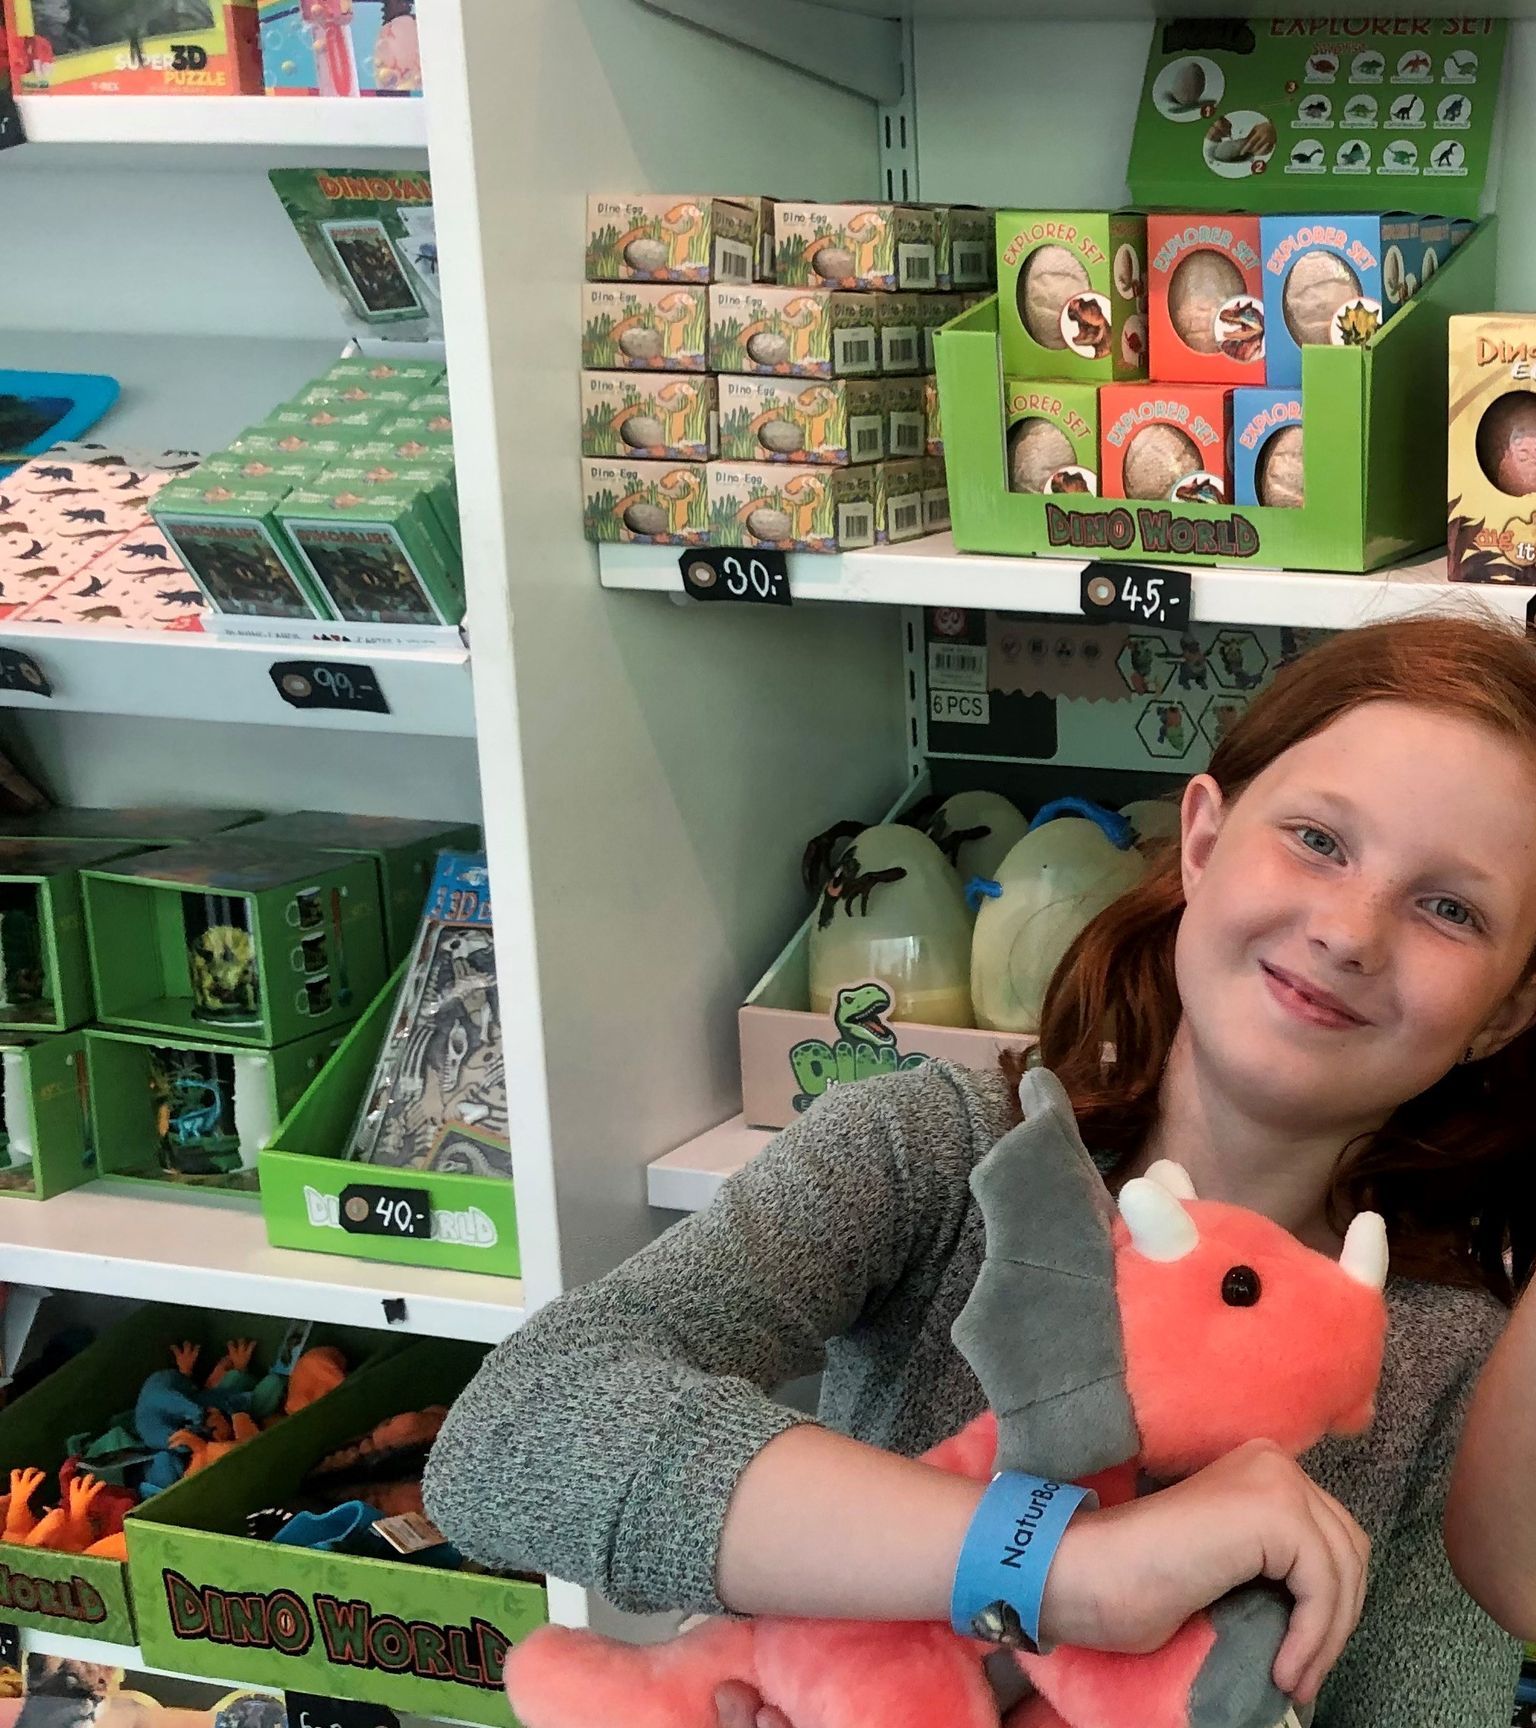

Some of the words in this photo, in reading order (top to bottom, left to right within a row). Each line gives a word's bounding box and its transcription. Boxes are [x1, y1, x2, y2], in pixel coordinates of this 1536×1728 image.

[171, 45, 208, 71] 3D
[164, 71, 227, 86] PUZZLE
[317, 175, 433, 201] DINOSA
[597, 203, 622, 215] Dino
[626, 204, 644, 216] Egg
[783, 212, 806, 223] Dino
[810, 213, 827, 225] Egg
[1003, 223, 1078, 267] EXPLORER
[1077, 235, 1106, 266] SET
[1153, 226, 1232, 274] EXPLORER
[1231, 239, 1261, 272] SET
[1266, 226, 1349, 277] EXPLORER
[1346, 239, 1378, 272] SET
[591, 292, 615, 303] Dino
[619, 293, 637, 305] Egg
[719, 294, 741, 306] Dino
[745, 295, 763, 308] Egg
[590, 380, 615, 392] Dino
[618, 381, 637, 394] Egg
[728, 383, 752, 395] Dino
[756, 385, 775, 397] Egg
[1005, 393, 1062, 416] LORER
[1063, 409, 1092, 441] SET
[1107, 401, 1188, 447] EXPLORER
[1190, 416, 1219, 448] SET
[1239, 401, 1302, 449] EXPLOR
[590, 468, 615, 479] Dino
[619, 470, 638, 481] Egg
[715, 472, 739, 484] Dino
[743, 474, 763, 486] Egg
[1045, 502, 1136, 552] DINO
[1137, 508, 1260, 558] WORLD
[1473, 527, 1515, 552] dig
[1515, 543, 1536, 561] it
[933, 696, 943, 714] 6
[947, 696, 983, 717] PCS
[430, 1206, 498, 1249] RLD
[162, 1567, 313, 1655] DINO
[313, 1592, 514, 1691] WORLD
